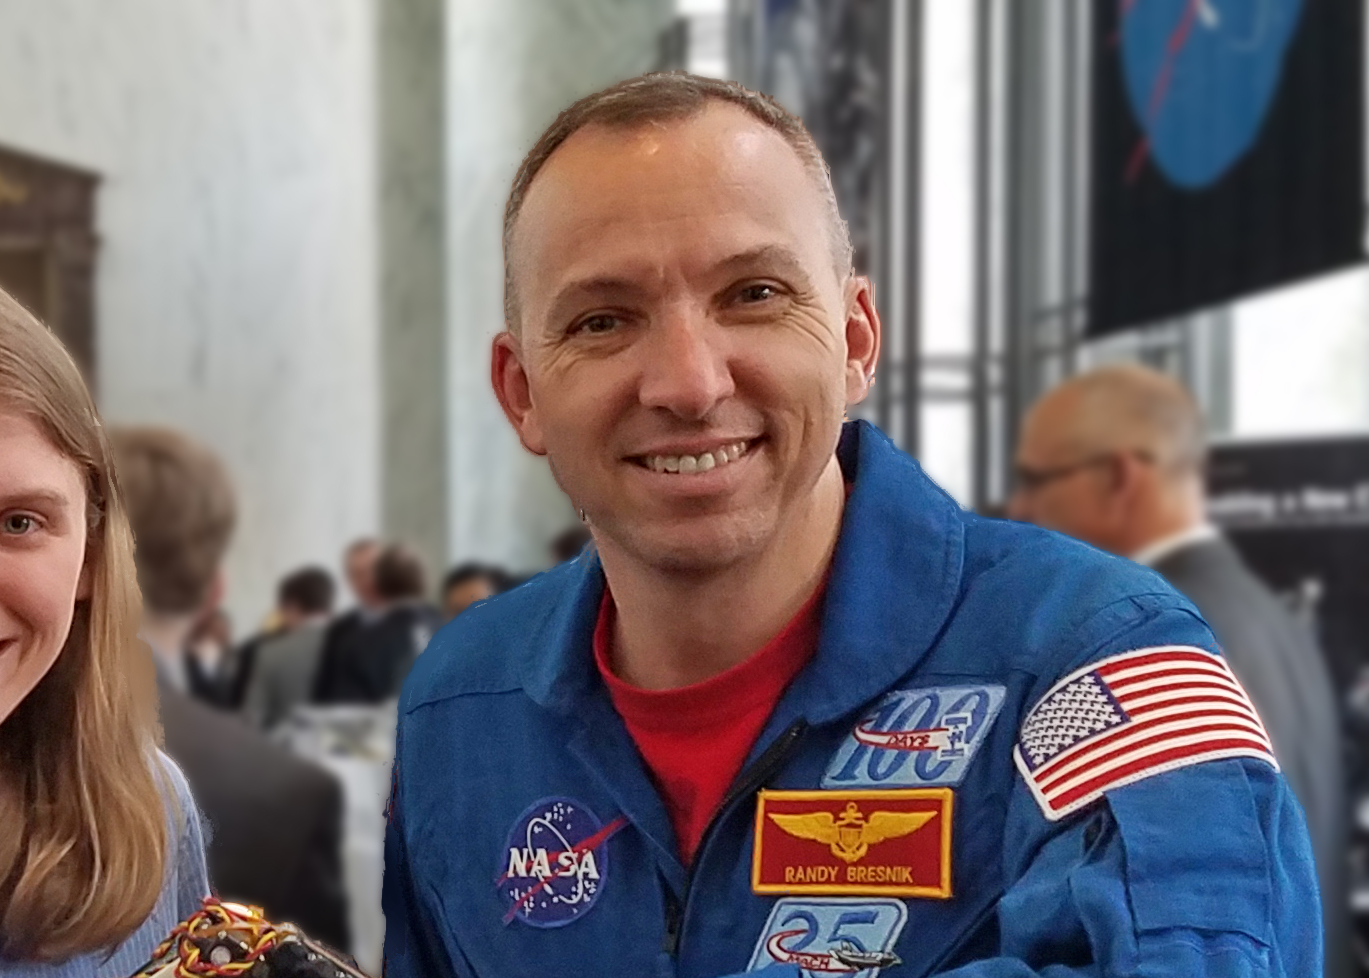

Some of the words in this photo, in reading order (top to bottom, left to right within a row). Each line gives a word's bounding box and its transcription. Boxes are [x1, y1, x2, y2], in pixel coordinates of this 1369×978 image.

[832, 689, 989, 781] 100
[886, 734, 931, 748] DAYS
[507, 847, 600, 879] NASA
[785, 865, 838, 882] RANDY
[847, 866, 913, 883] BRESNIK
[787, 954, 831, 968] MACH
